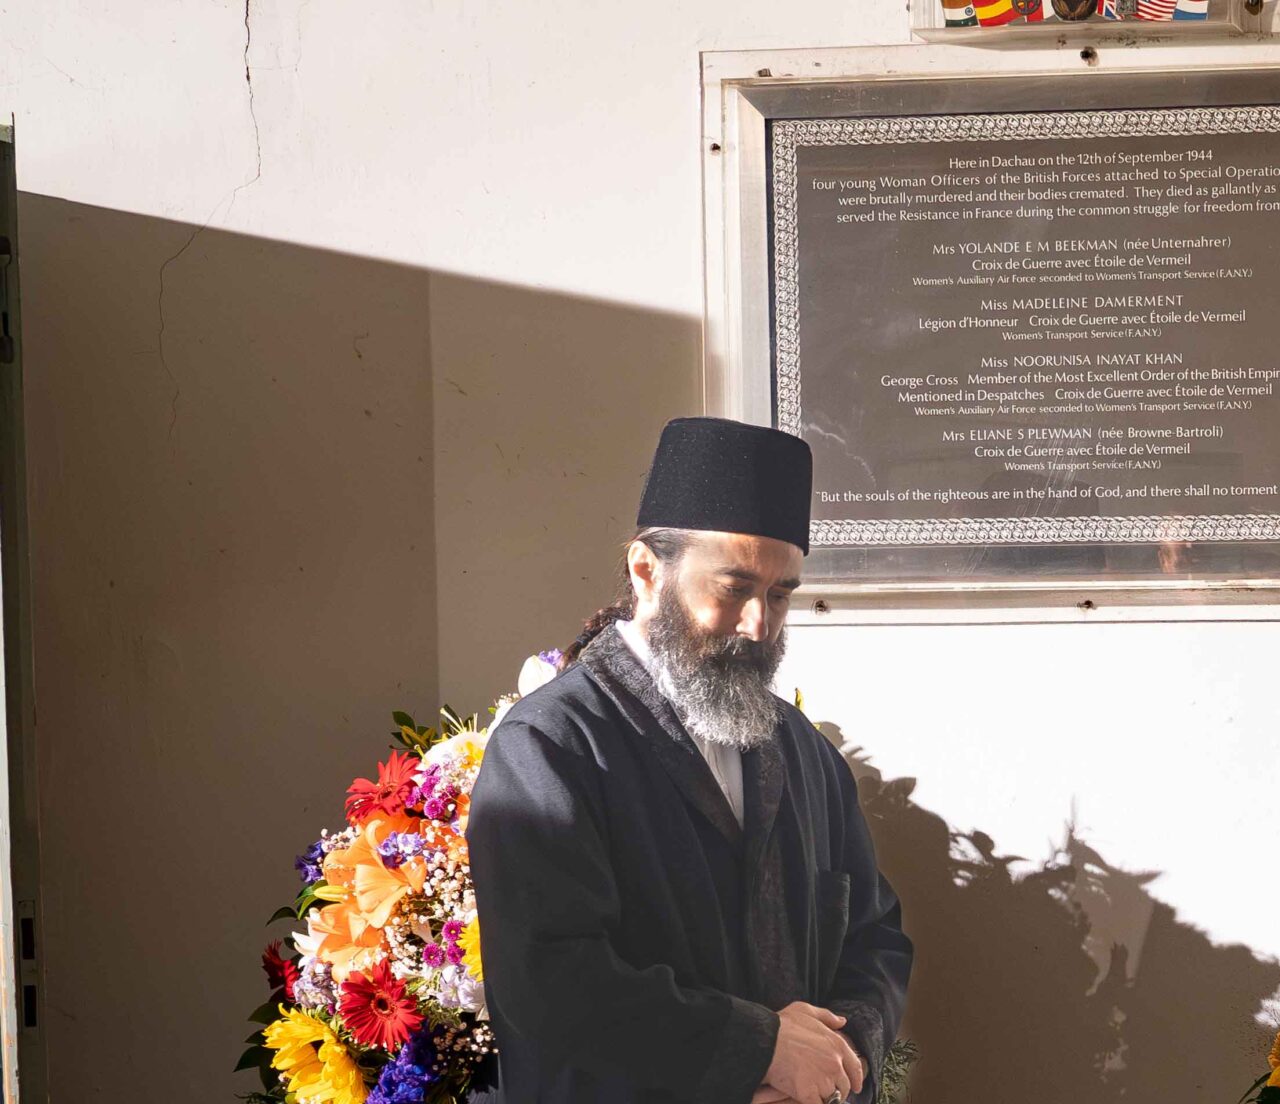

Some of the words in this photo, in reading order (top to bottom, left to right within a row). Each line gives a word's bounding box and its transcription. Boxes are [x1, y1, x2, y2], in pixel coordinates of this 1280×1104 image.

[949, 157, 977, 169] Here
[979, 157, 990, 168] in
[991, 154, 1036, 168] Dachau
[1038, 157, 1054, 166] on
[1056, 153, 1076, 166] the
[1077, 152, 1102, 165] 12th
[1104, 152, 1116, 164] of
[1118, 150, 1184, 169] September
[1185, 149, 1213, 162] 1944
[812, 178, 836, 190] four
[839, 180, 876, 192] young
[879, 176, 926, 188] Woman
[930, 174, 980, 187] Officers
[984, 172, 998, 185] of
[1000, 172, 1020, 184] the
[1024, 171, 1059, 186] British
[1062, 171, 1101, 183] Forces
[1104, 168, 1159, 182] attached
[1163, 170, 1177, 180] to
[1179, 165, 1222, 183] Special
[838, 197, 867, 206] were
[869, 190, 913, 207] brutally
[915, 190, 973, 204] murdered
[975, 189, 997, 202] and
[999, 189, 1026, 201] their
[1027, 188, 1067, 200] bodies
[1069, 186, 1128, 200] cremated.
[1133, 186, 1164, 201] They
[1166, 184, 1193, 197] died
[1195, 187, 1208, 196] as
[1211, 182, 1262, 199] gallantly
[1264, 185, 1276, 194] as
[836, 210, 875, 223] served
[878, 210, 897, 222] the
[899, 209, 960, 221] Resistance
[962, 208, 973, 220] in
[975, 207, 1013, 219] France
[1016, 206, 1054, 221] during
[1056, 204, 1076, 217] the
[1078, 206, 1130, 216] common
[1133, 202, 1180, 218] struggle
[1183, 201, 1201, 214] for
[1203, 200, 1253, 213] freedom
[932, 244, 956, 255] Mrs
[958, 241, 1020, 254] YOLANDE
[1026, 241, 1032, 253] E
[1037, 241, 1050, 252] M
[1055, 239, 1118, 254] BEEKMAN
[1123, 238, 1150, 251] (née
[972, 259, 1003, 271] Croix
[1004, 258, 1020, 270] de
[1022, 258, 1062, 270] Guerre
[1064, 259, 1091, 268] avec
[1094, 254, 1126, 268] Étoile
[1128, 254, 1144, 267] de
[1146, 253, 1191, 266] Vermeil
[956, 275, 995, 286] Auxiliary
[1012, 274, 1036, 283] Force
[1138, 270, 1182, 282] Transport
[980, 299, 1008, 311] Miss
[1012, 297, 1088, 310] MADELEINE
[1094, 295, 1184, 310] DAMERMENT
[919, 318, 956, 333] Légion
[1029, 315, 1060, 327] Croix
[1061, 314, 1077, 326] de
[1078, 314, 1119, 326] Guerre
[1121, 315, 1147, 325] avec
[1150, 310, 1182, 324] Étoile
[1184, 310, 1200, 323] de
[1200, 309, 1246, 323] Vermeil
[981, 357, 1008, 368] Miss
[1014, 354, 1092, 367] NOORUNISA
[1096, 354, 1142, 366] INAYAT
[1145, 353, 1183, 365] KHAN
[880, 375, 924, 390] George
[926, 374, 959, 386] Cross
[967, 372, 1018, 385] Member
[1019, 371, 1032, 384] of
[1033, 371, 1053, 384] the
[1054, 372, 1084, 383] Most
[1087, 370, 1138, 383] Excellent
[1140, 369, 1176, 381] Order
[1176, 368, 1189, 383] of
[1190, 368, 1210, 380] the
[1211, 367, 1246, 380] British
[898, 388, 962, 403] Mentioned
[964, 390, 975, 401] in
[977, 388, 1045, 404] Despatches
[1055, 388, 1085, 400] Croix
[1086, 387, 1102, 400] de
[1103, 387, 1144, 399] Guerre
[1146, 388, 1172, 398] avec
[1175, 383, 1208, 397] Étoile
[1209, 384, 1224, 397] de
[1226, 383, 1272, 396] Vermeil
[958, 405, 996, 417] Auxiliary
[1011, 404, 1036, 414] Force
[1138, 402, 1181, 414] Transport
[942, 431, 965, 442] Mrs
[970, 428, 1013, 441] ELIANE
[1017, 428, 1024, 440] S
[1028, 428, 1092, 442] PLEWMAN
[1098, 426, 1124, 439] (née
[1128, 425, 1224, 439] Browne-Bartroli)
[974, 446, 1005, 458] Croix
[1006, 445, 1022, 457] de
[1024, 445, 1064, 457] Guerre
[1065, 447, 1093, 456] avec
[1096, 442, 1128, 456] Étoile
[1128, 443, 1144, 455] de
[1145, 442, 1190, 455] Vermeil
[843, 490, 863, 502] the
[865, 489, 895, 502] souls
[897, 489, 910, 501] of
[912, 489, 932, 501] the
[934, 488, 989, 504] righteous
[991, 491, 1010, 500] are
[1013, 488, 1024, 499] in
[1026, 487, 1046, 499] the
[1048, 486, 1077, 499] hand
[1080, 486, 1092, 498] of
[1094, 485, 1124, 499] God,
[1125, 485, 1147, 498] and
[1150, 485, 1182, 497] there
[1184, 484, 1210, 497] shall
[1212, 487, 1229, 496] no
[1230, 485, 1278, 496] torment
